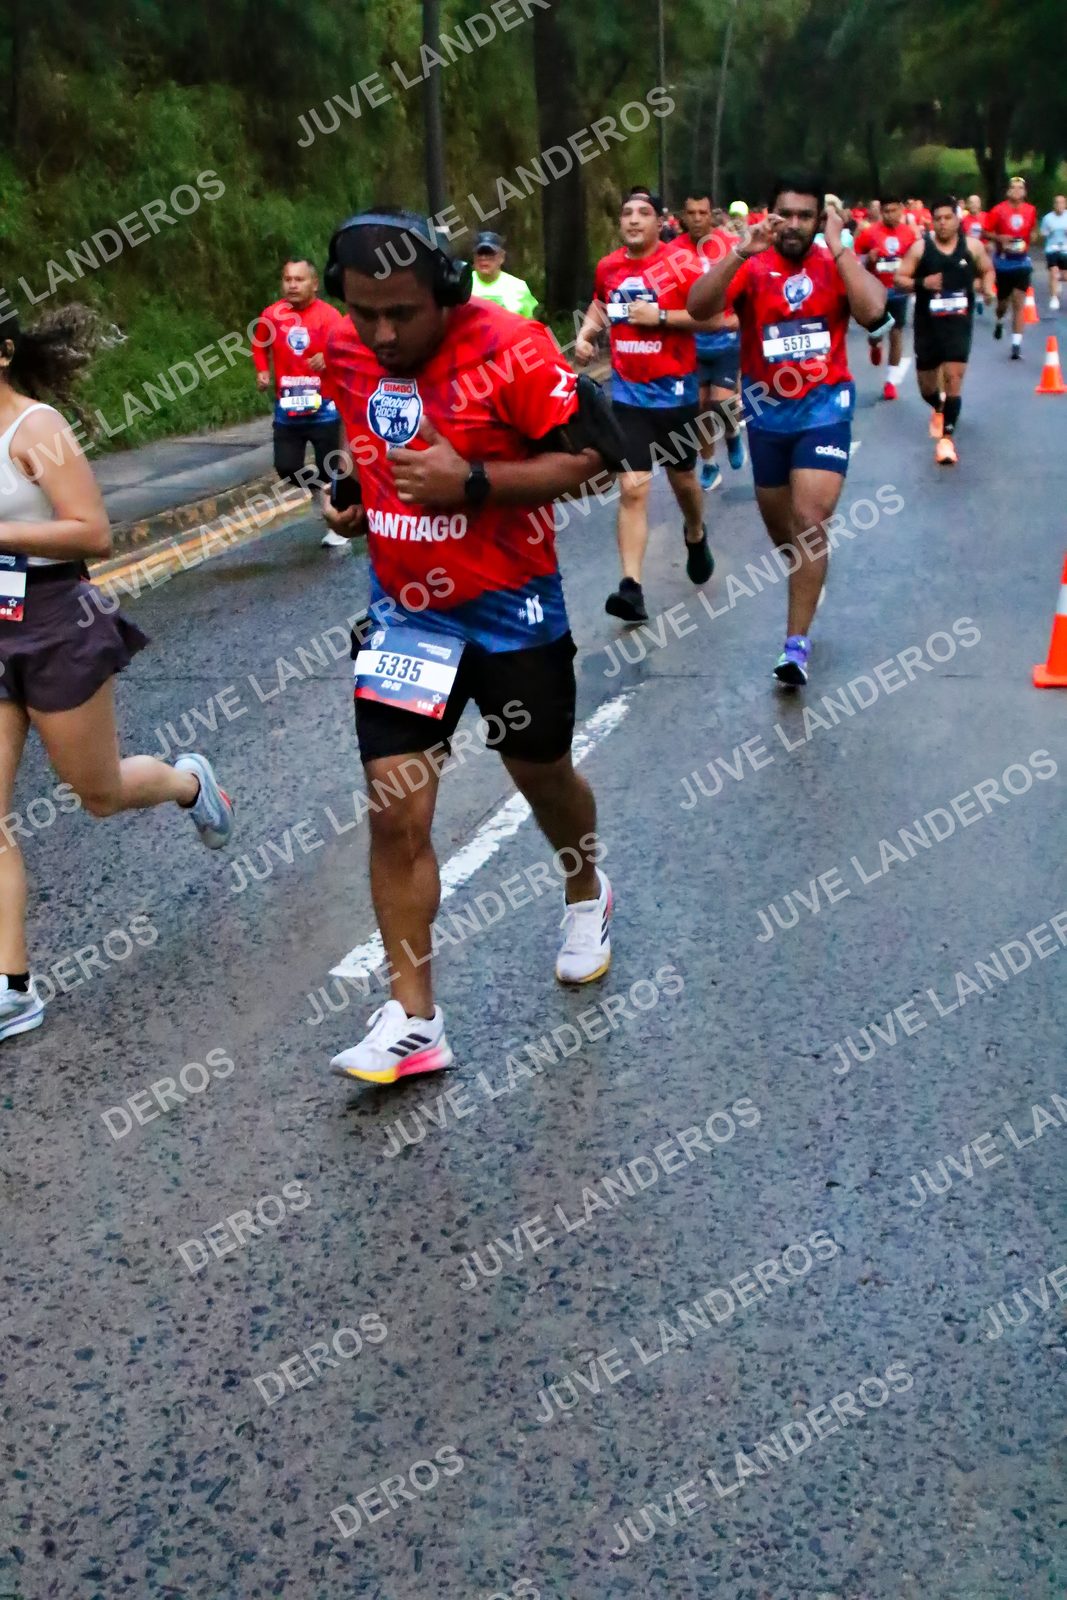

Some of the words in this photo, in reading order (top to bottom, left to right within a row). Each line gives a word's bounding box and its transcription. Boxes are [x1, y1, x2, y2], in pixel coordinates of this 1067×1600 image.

[783, 335, 811, 351] 5573
[383, 383, 413, 394] BIMBO
[381, 396, 411, 410] Global
[375, 405, 398, 418] Race
[366, 508, 468, 542] SANTIAGO
[375, 654, 424, 682] 5335
